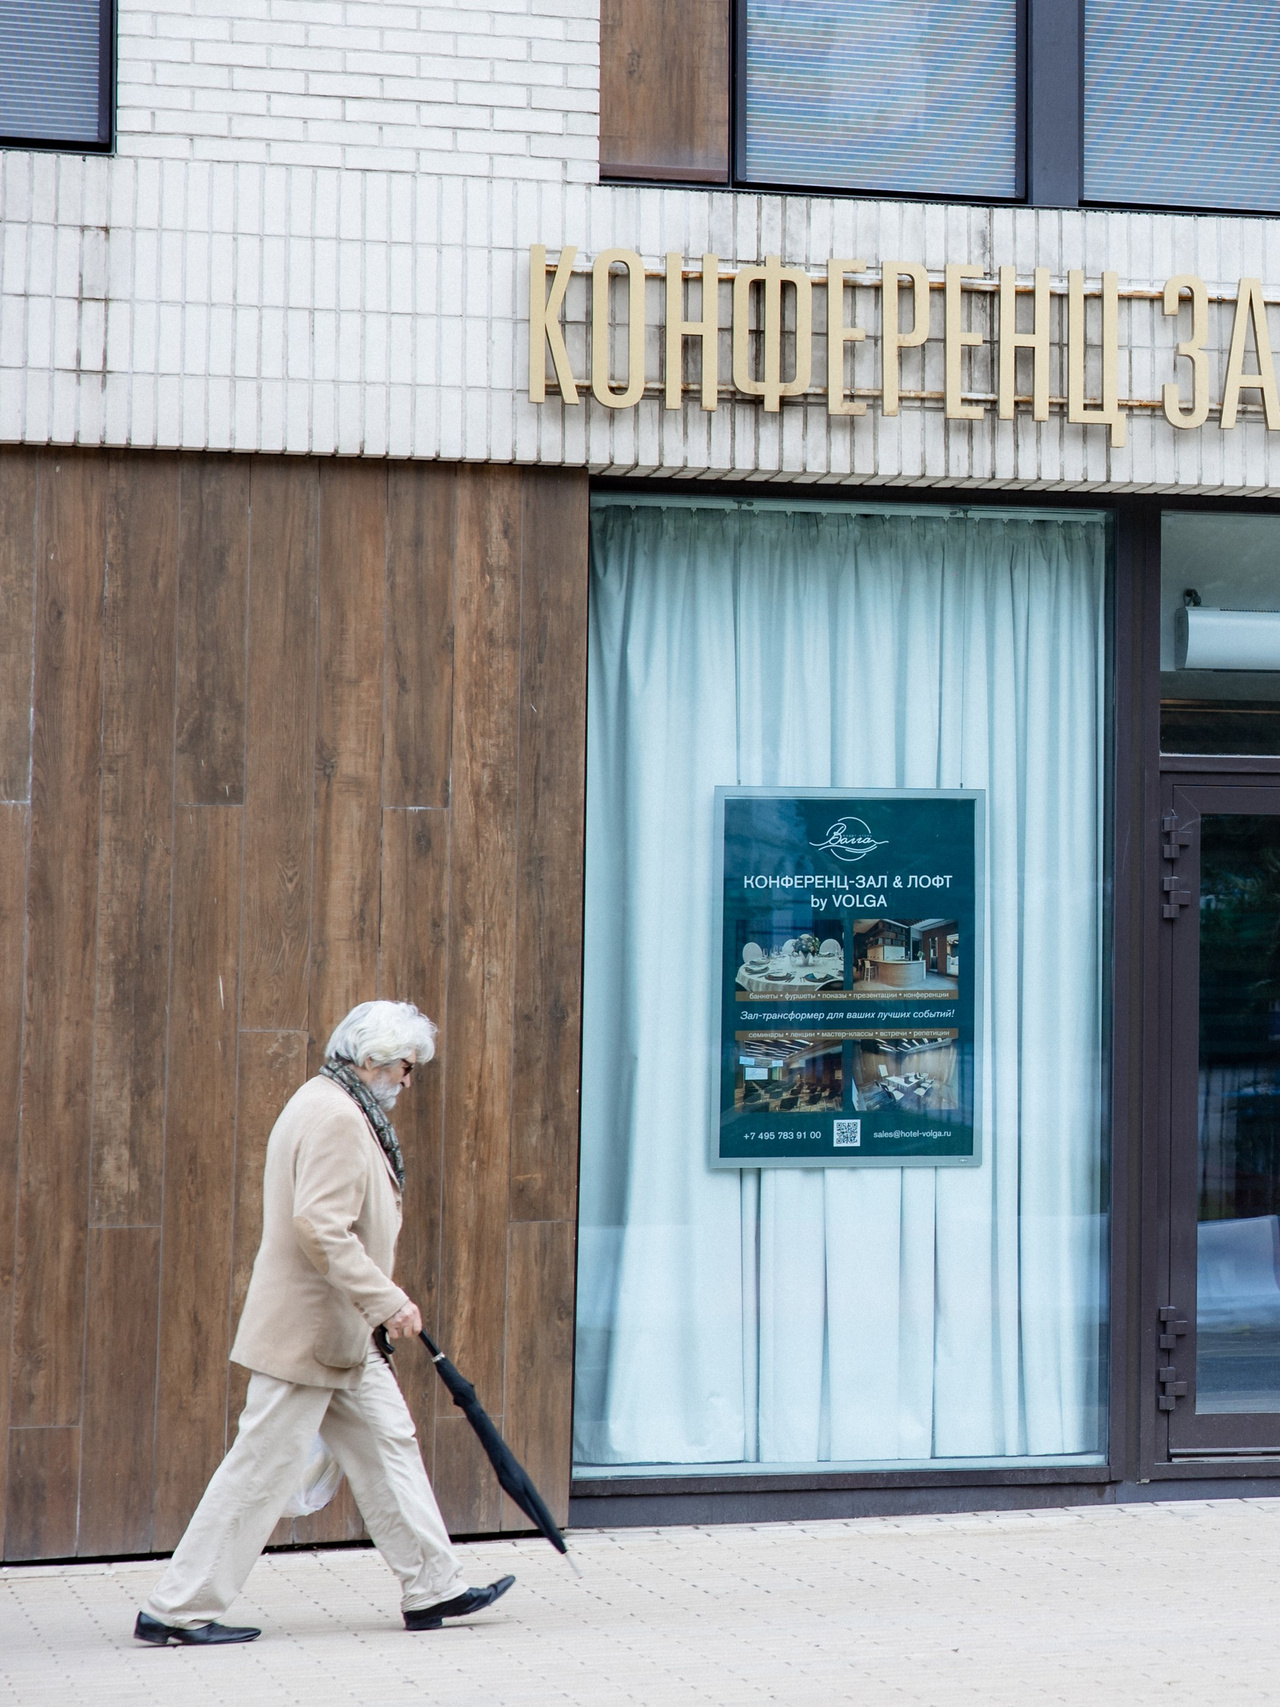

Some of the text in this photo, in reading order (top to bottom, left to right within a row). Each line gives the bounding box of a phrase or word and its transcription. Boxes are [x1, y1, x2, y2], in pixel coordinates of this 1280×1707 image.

[529, 243, 1126, 448] КОНФЕРЕНЦ
[743, 875, 953, 891] КОНФЕРЕНЦ-ЗАЛ & ЛОФТ
[810, 894, 888, 911] by VOLGA
[749, 992, 779, 1000] банкеты
[784, 992, 817, 1001] фуршеты
[853, 992, 898, 1000] презентации
[903, 992, 950, 1000] конференции
[740, 1010, 825, 1022] Зал-трансформер
[826, 1012, 845, 1020] для
[877, 1011, 911, 1021] лучших
[912, 1009, 956, 1019] событий!
[821, 1031, 874, 1039] мастер-классы
[743, 1131, 822, 1140] +7 495 783 91 00
[873, 1129, 952, 1139] sales@hotel-volga.ru
